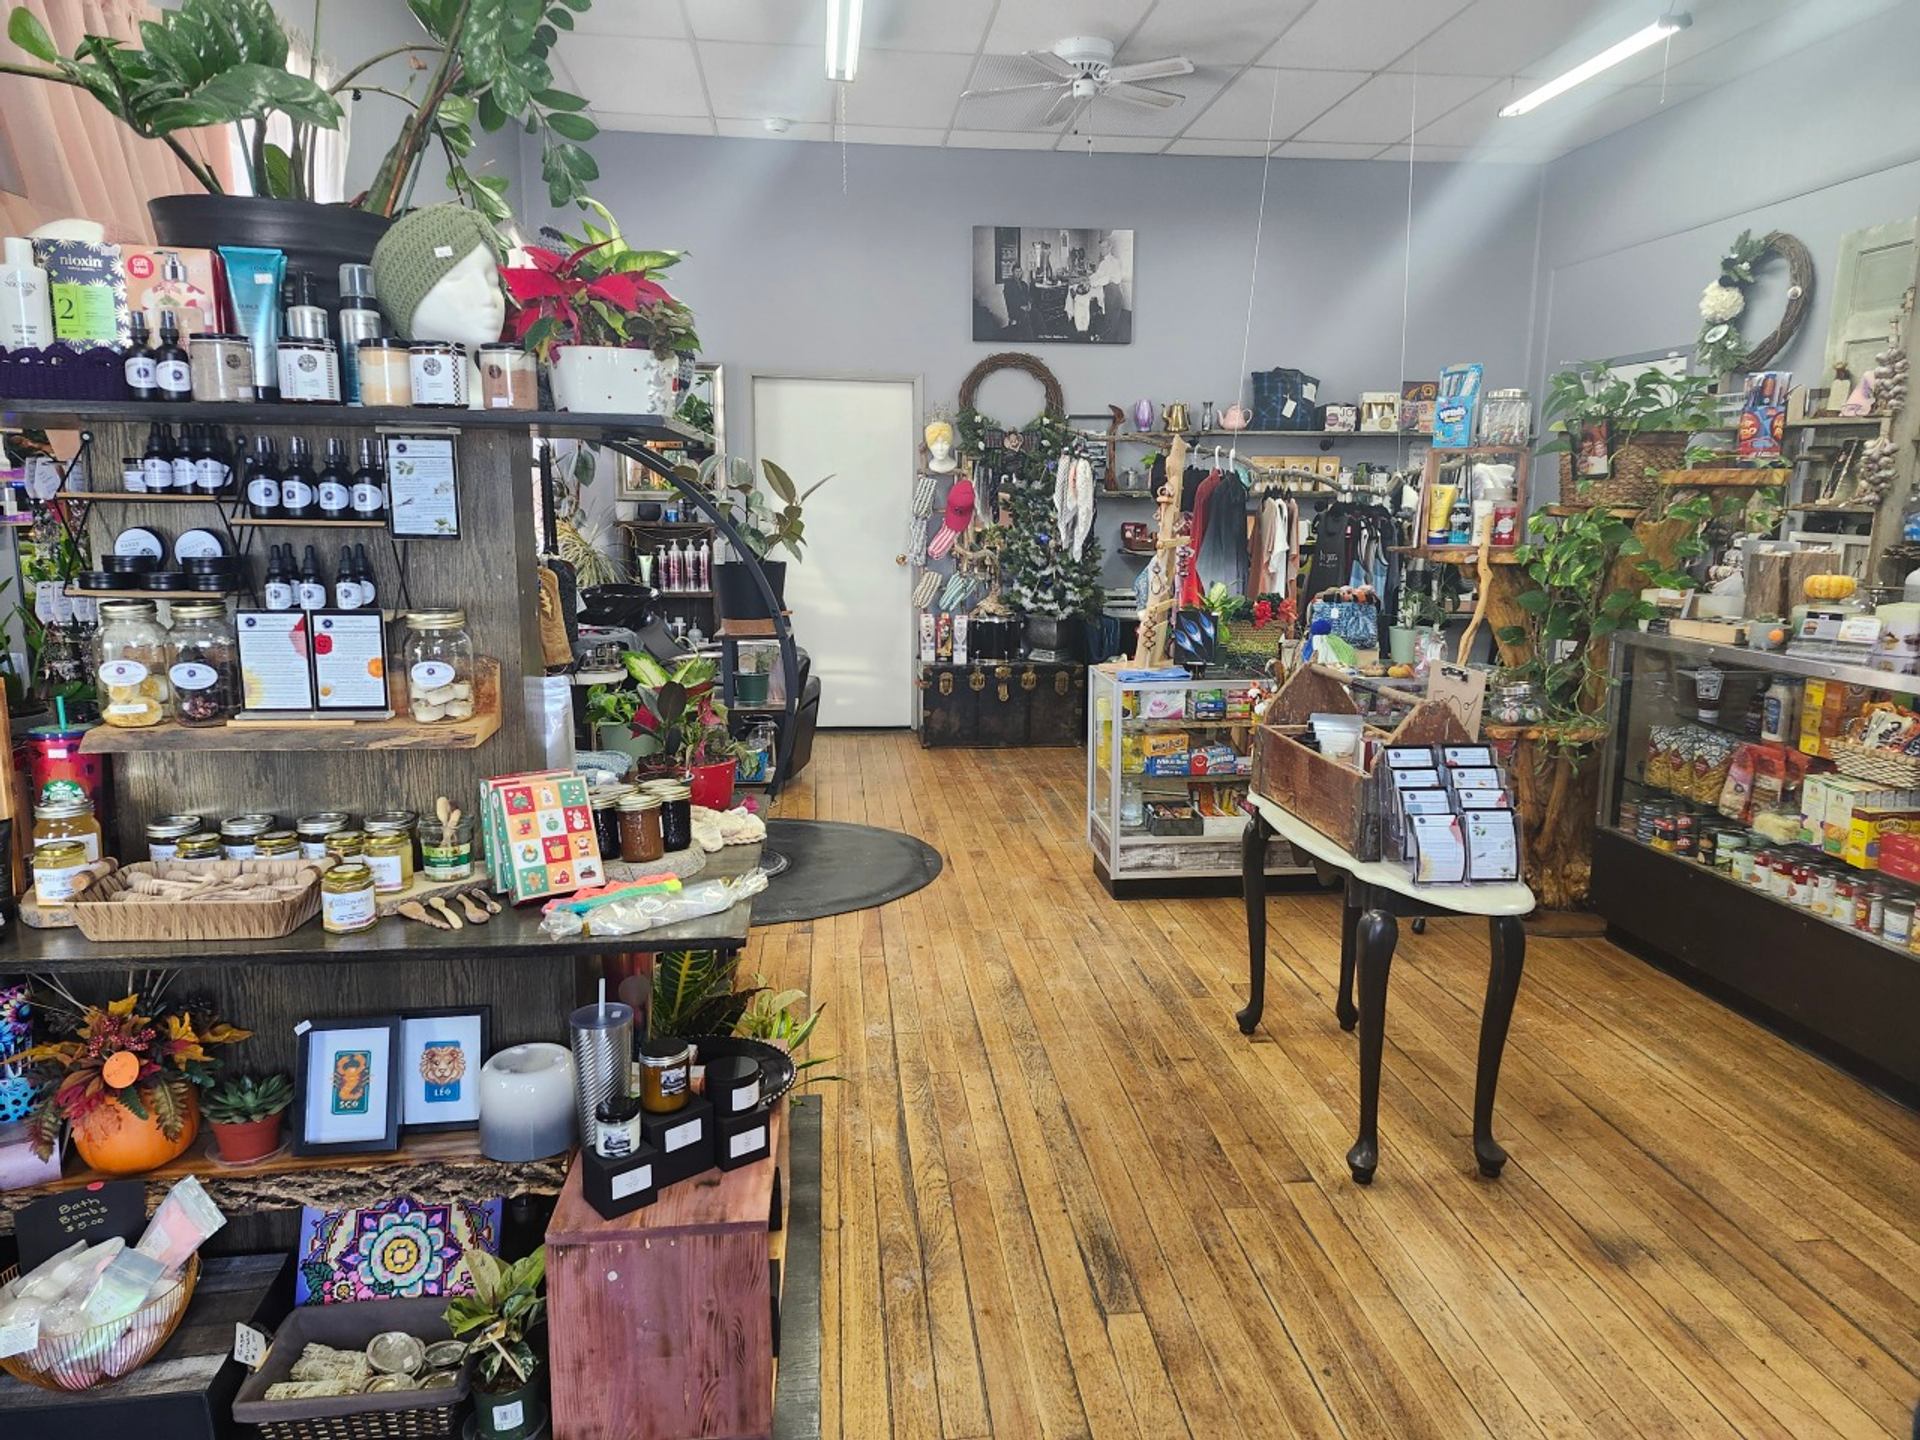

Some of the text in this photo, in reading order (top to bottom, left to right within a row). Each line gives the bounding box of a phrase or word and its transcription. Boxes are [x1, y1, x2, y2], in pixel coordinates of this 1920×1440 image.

[58, 297, 74, 320] 2
[434, 1088, 452, 1097] LEO
[339, 1101, 359, 1109] SCO
[58, 1198, 101, 1215] Bath
[58, 1206, 108, 1225] Bombs
